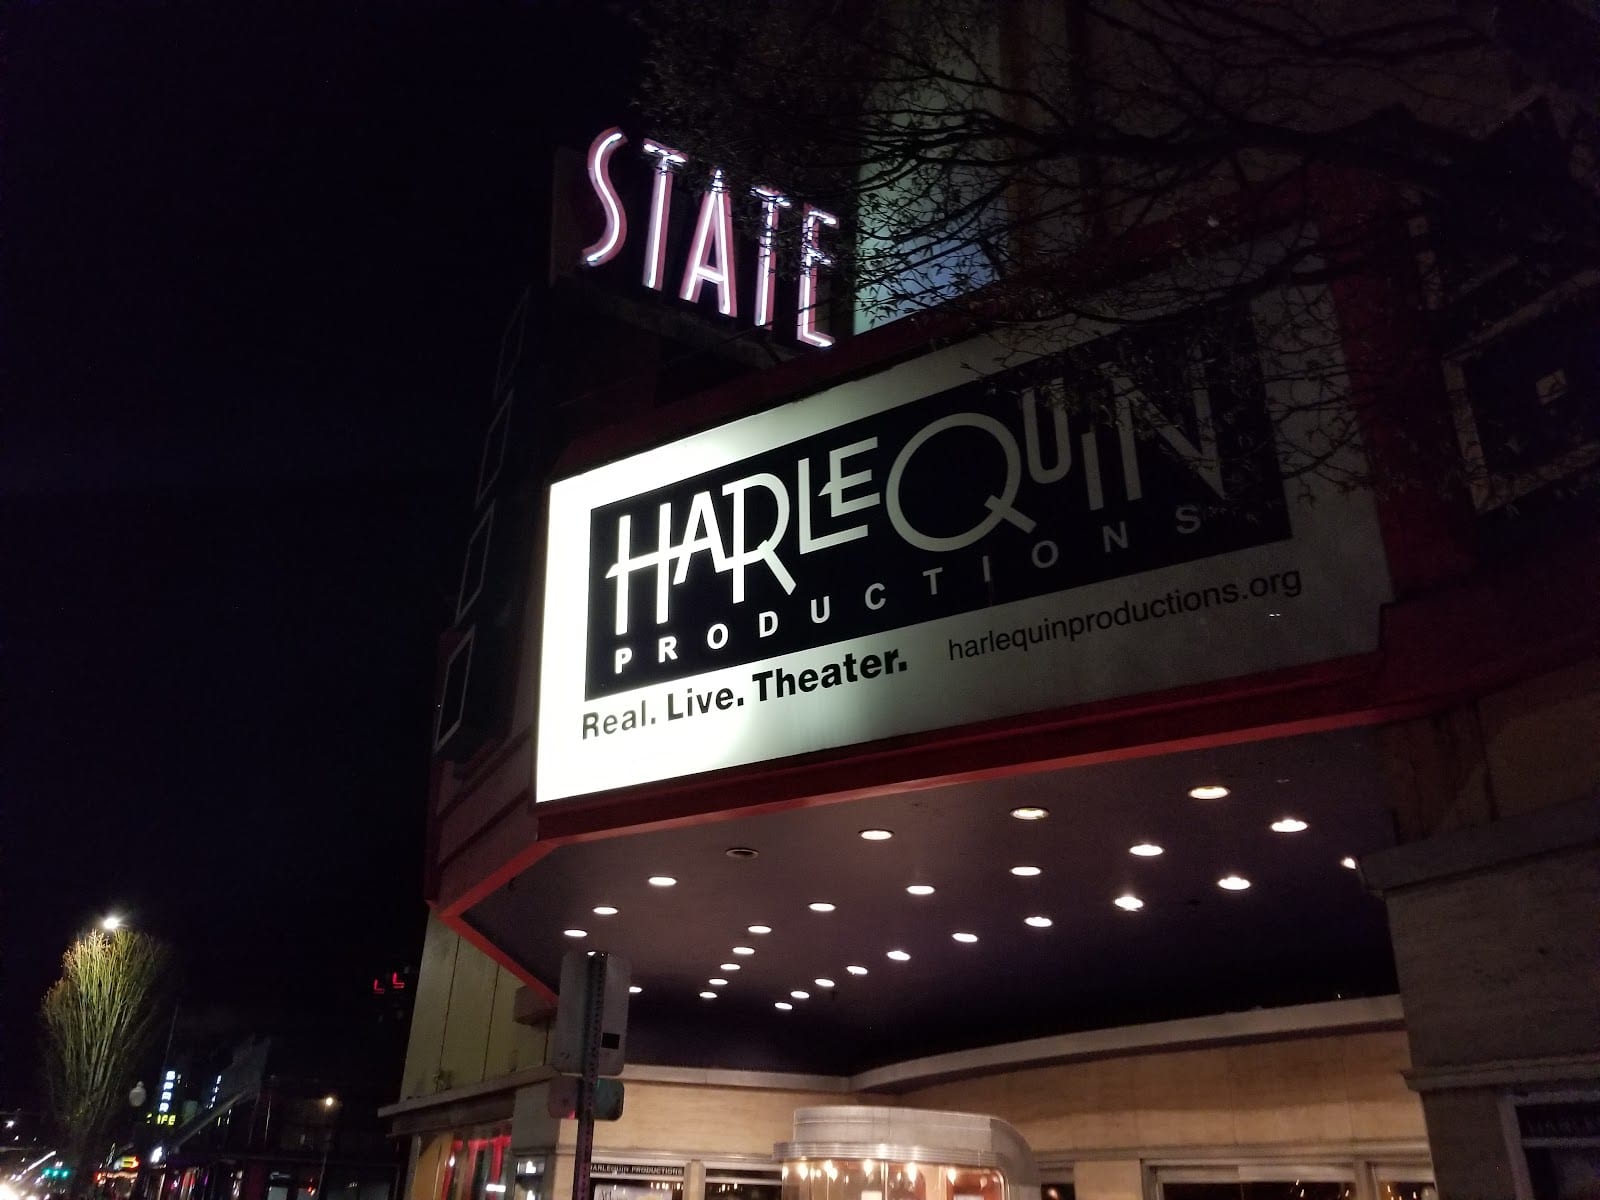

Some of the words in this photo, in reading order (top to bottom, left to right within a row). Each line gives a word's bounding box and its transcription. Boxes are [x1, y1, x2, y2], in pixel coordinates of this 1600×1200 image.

[582, 125, 840, 348] STATE
[605, 348, 1228, 636] HARLEQUIN
[614, 503, 1202, 675] PRODUCTIONS
[948, 568, 1302, 661] harlequinproductions.org
[582, 700, 656, 740] Real.
[667, 687, 744, 721] Live.
[752, 648, 908, 702] Theater.
